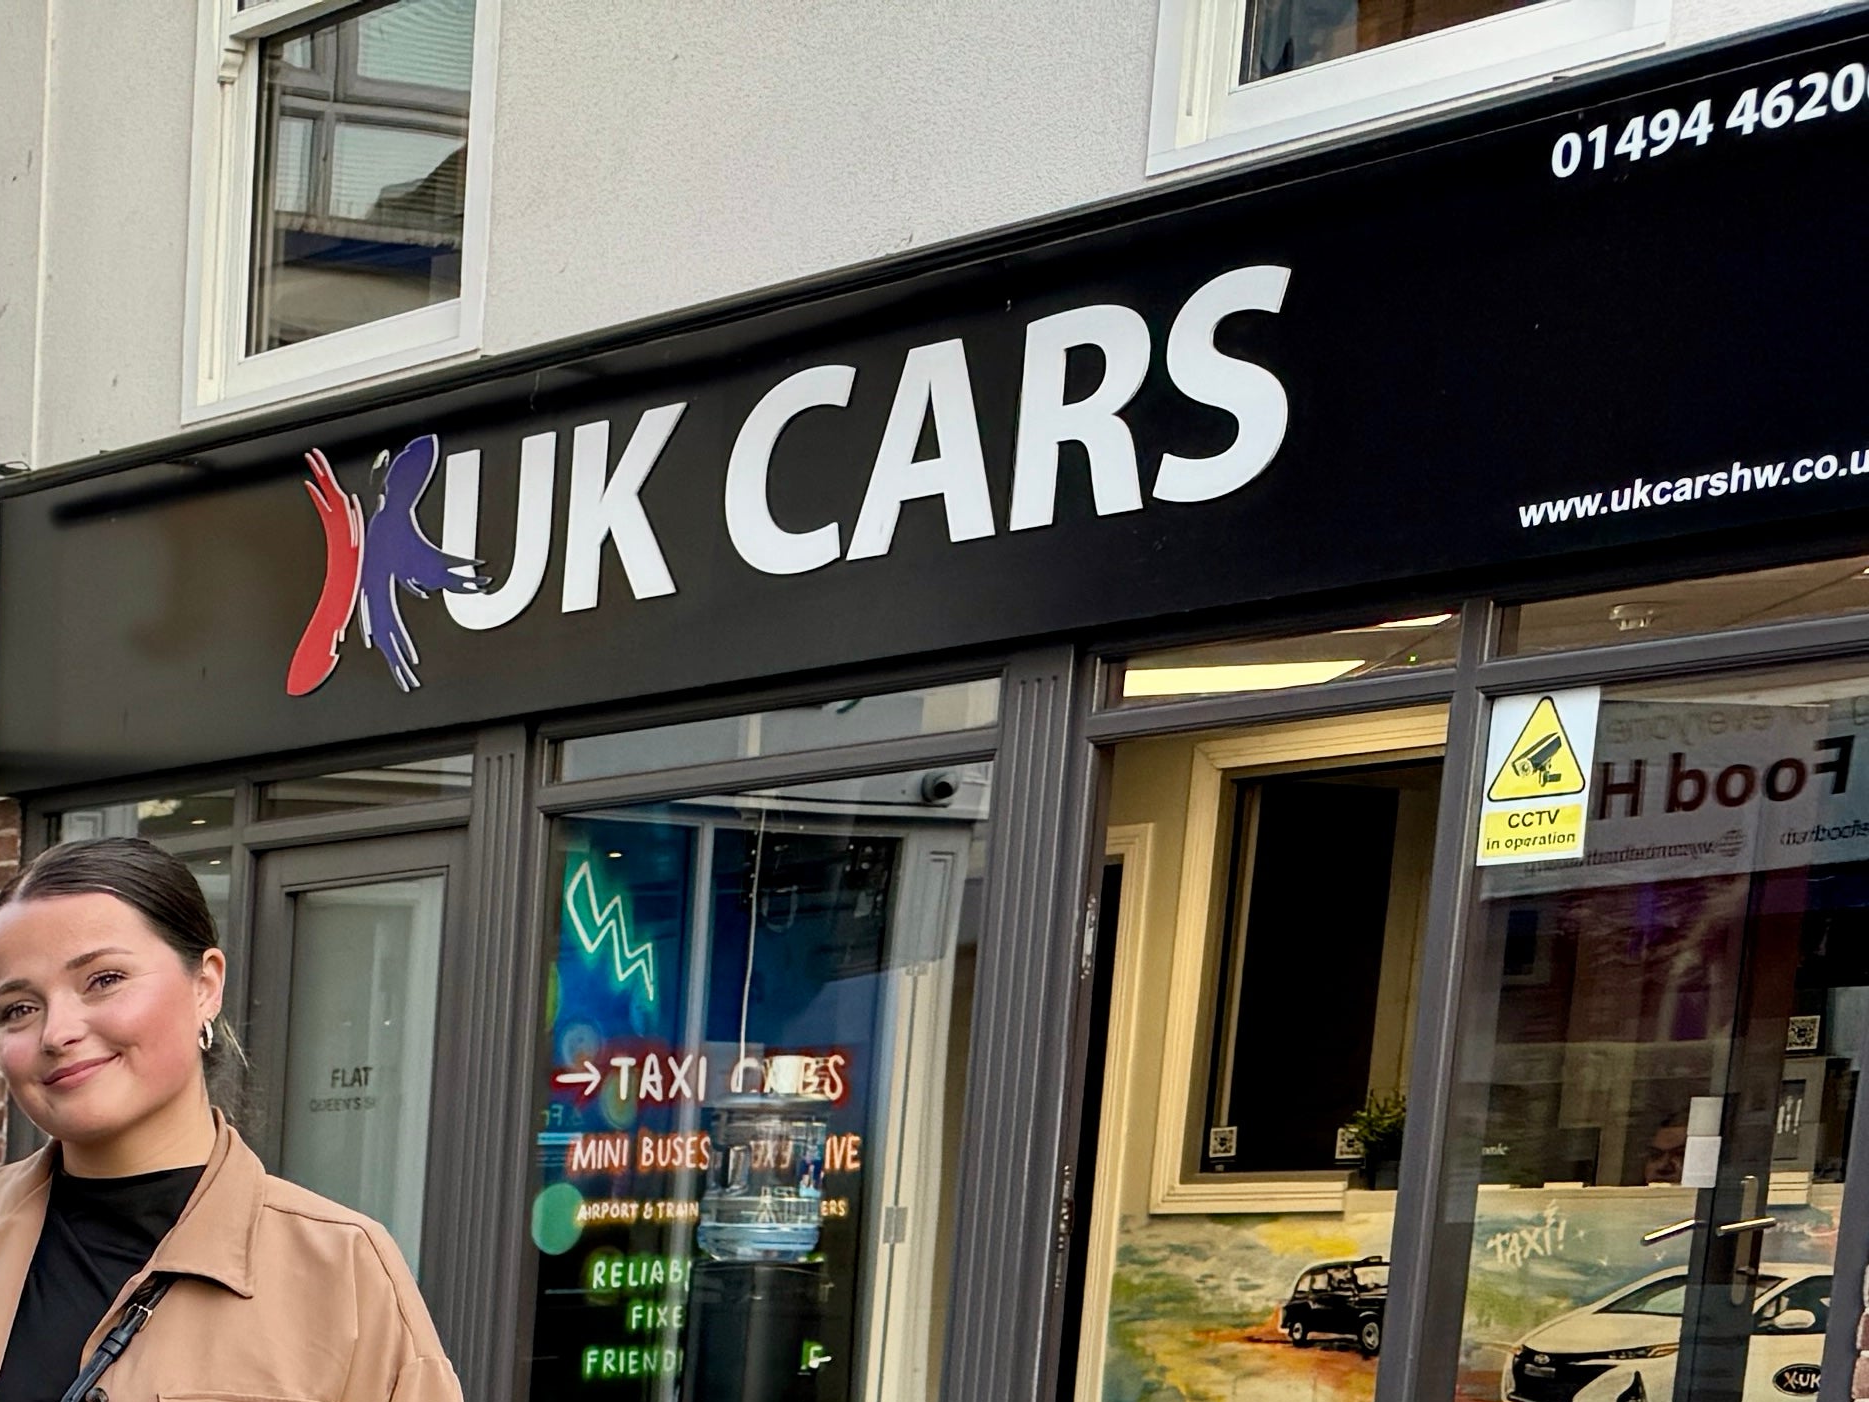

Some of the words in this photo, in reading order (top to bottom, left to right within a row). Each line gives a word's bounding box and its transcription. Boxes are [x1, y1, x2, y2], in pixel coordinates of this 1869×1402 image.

[1551, 98, 1714, 179] 01494
[1725, 60, 1869, 138] 4620
[725, 265, 1292, 577] CARS
[1508, 810, 1559, 829] CCTV
[1486, 838, 1499, 850] in
[1504, 832, 1576, 849] operation
[331, 1066, 373, 1088] FLAT
[611, 1052, 707, 1101] TAXI
[572, 1139, 628, 1172] MINI
[641, 1135, 711, 1170] BUSES
[577, 1201, 638, 1221] AIRPORT
[643, 1202, 653, 1219] &
[657, 1202, 699, 1219] TRAIN
[631, 1305, 684, 1330] FIXE
